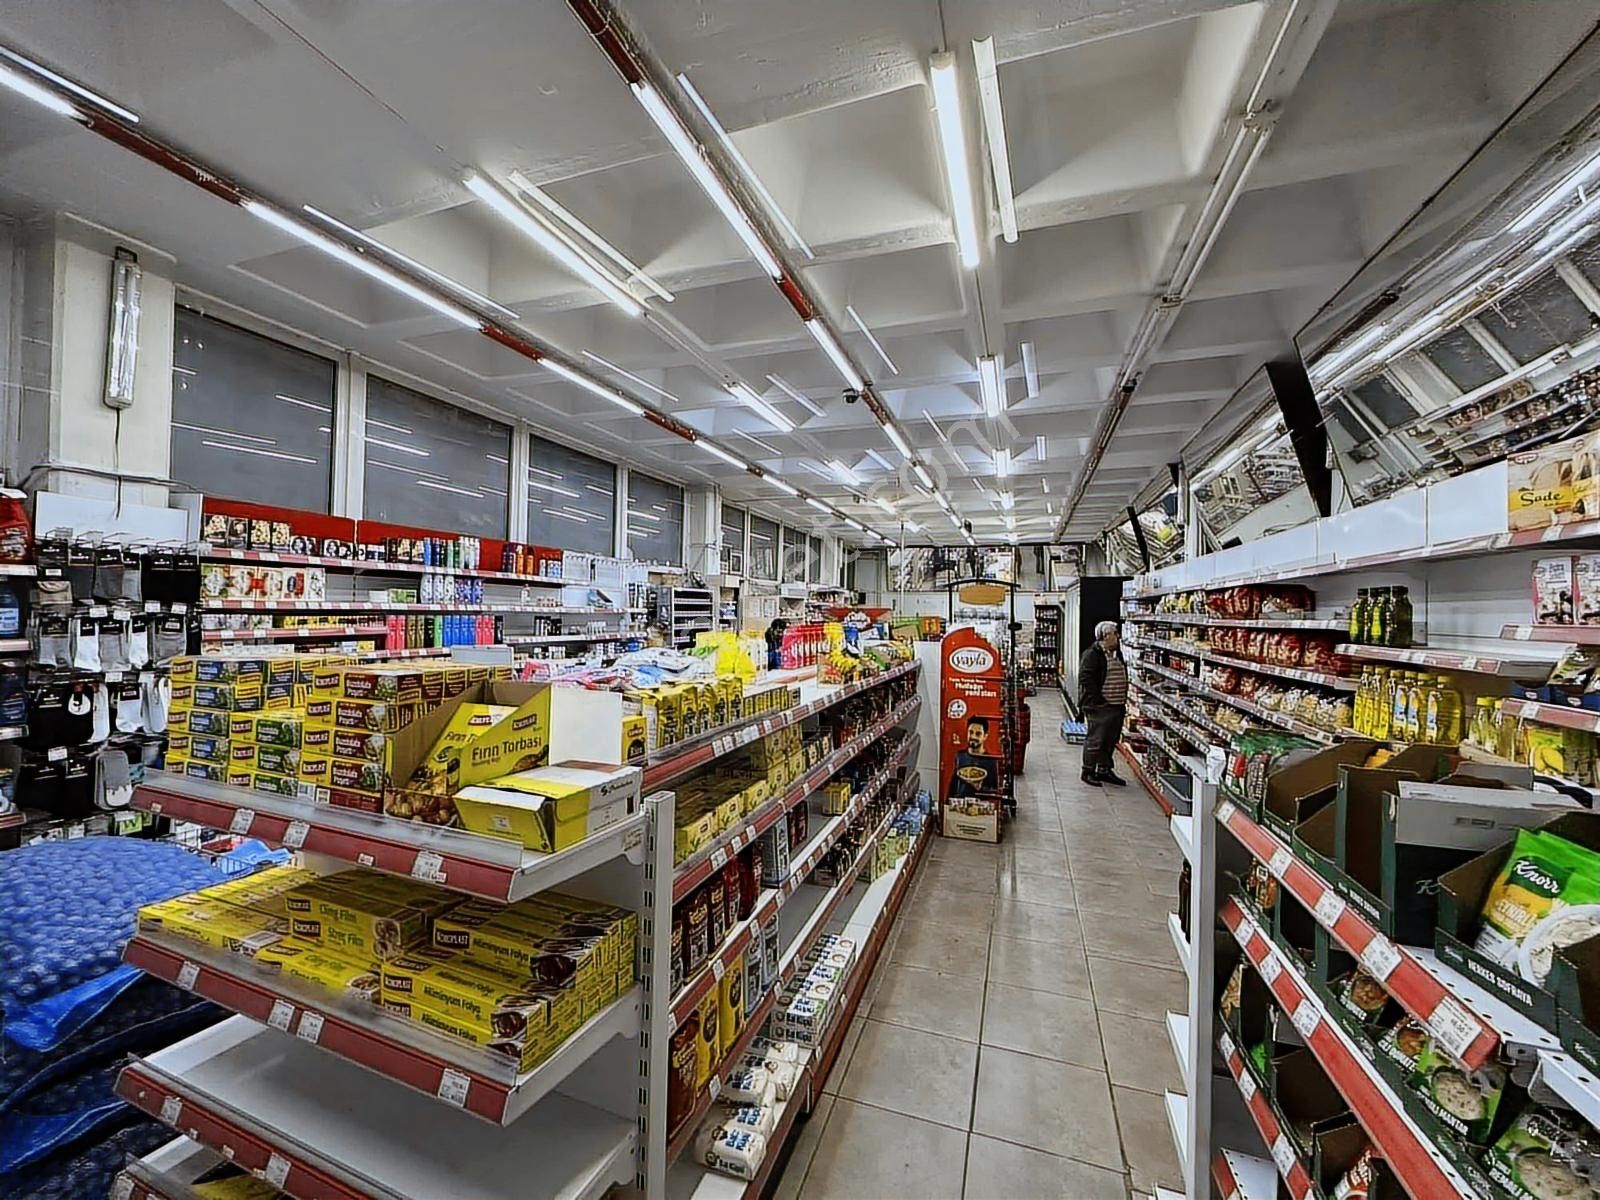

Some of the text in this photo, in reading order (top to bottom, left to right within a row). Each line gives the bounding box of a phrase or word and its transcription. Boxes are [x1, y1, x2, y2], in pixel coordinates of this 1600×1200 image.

[1520, 491, 1564, 507] Sade
[956, 653, 986, 668] yayla
[472, 737, 542, 761] Fırın Torbası
[1513, 859, 1560, 893] Knorr
